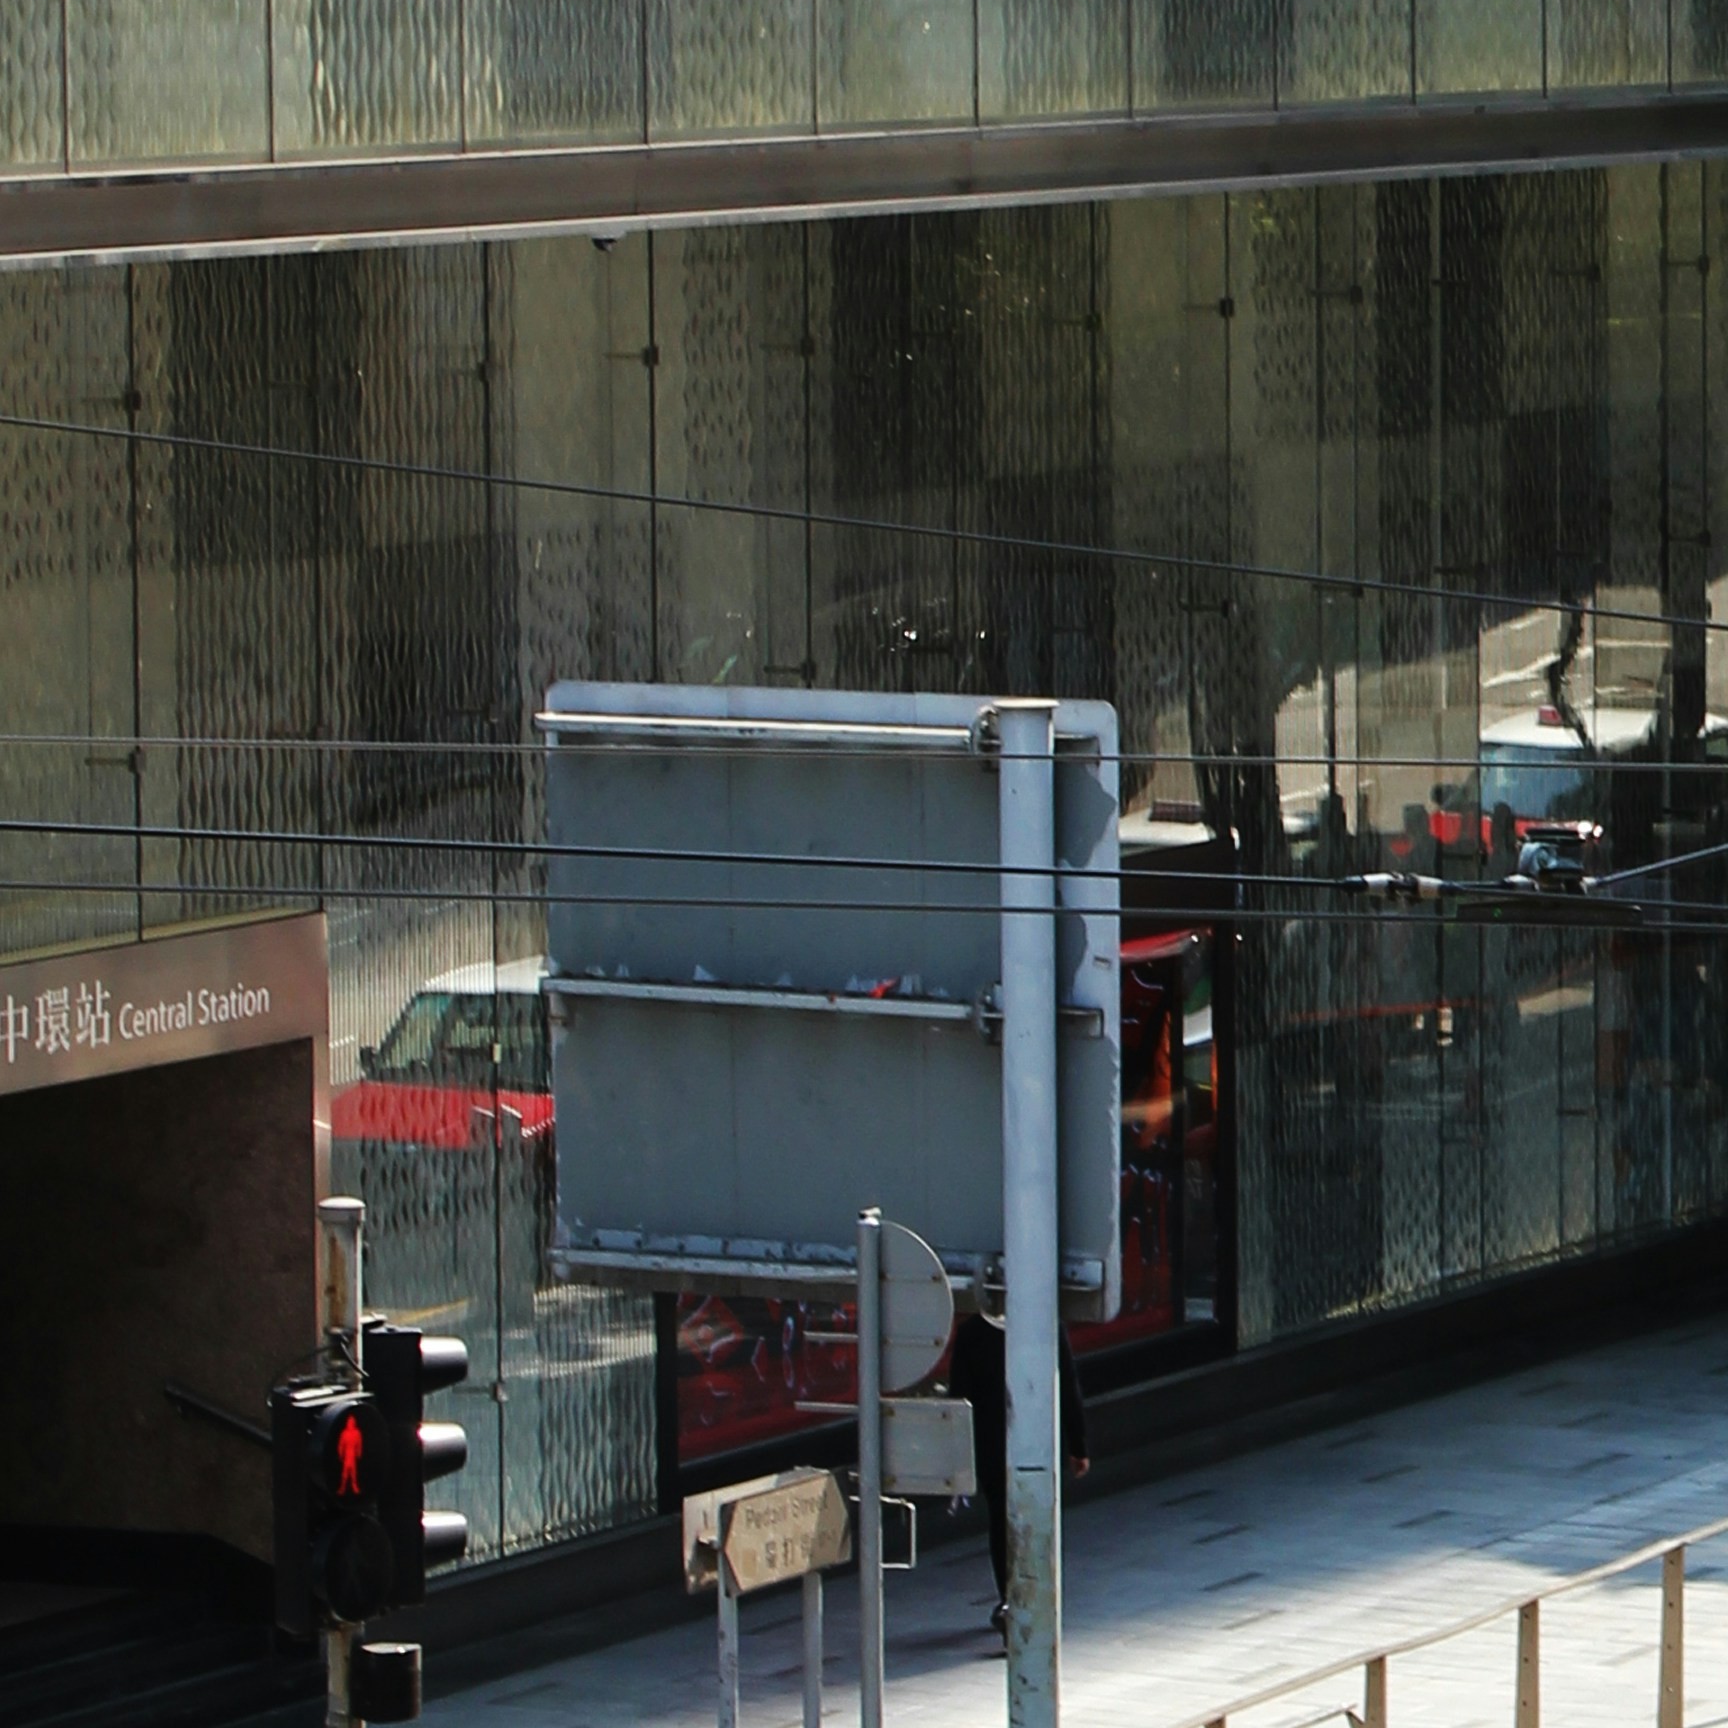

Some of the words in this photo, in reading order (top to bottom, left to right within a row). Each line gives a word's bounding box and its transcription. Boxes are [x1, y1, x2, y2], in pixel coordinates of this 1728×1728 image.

[0, 979, 112, 1064] 中環站
[118, 990, 193, 1040] Central
[198, 981, 271, 1026] Station
